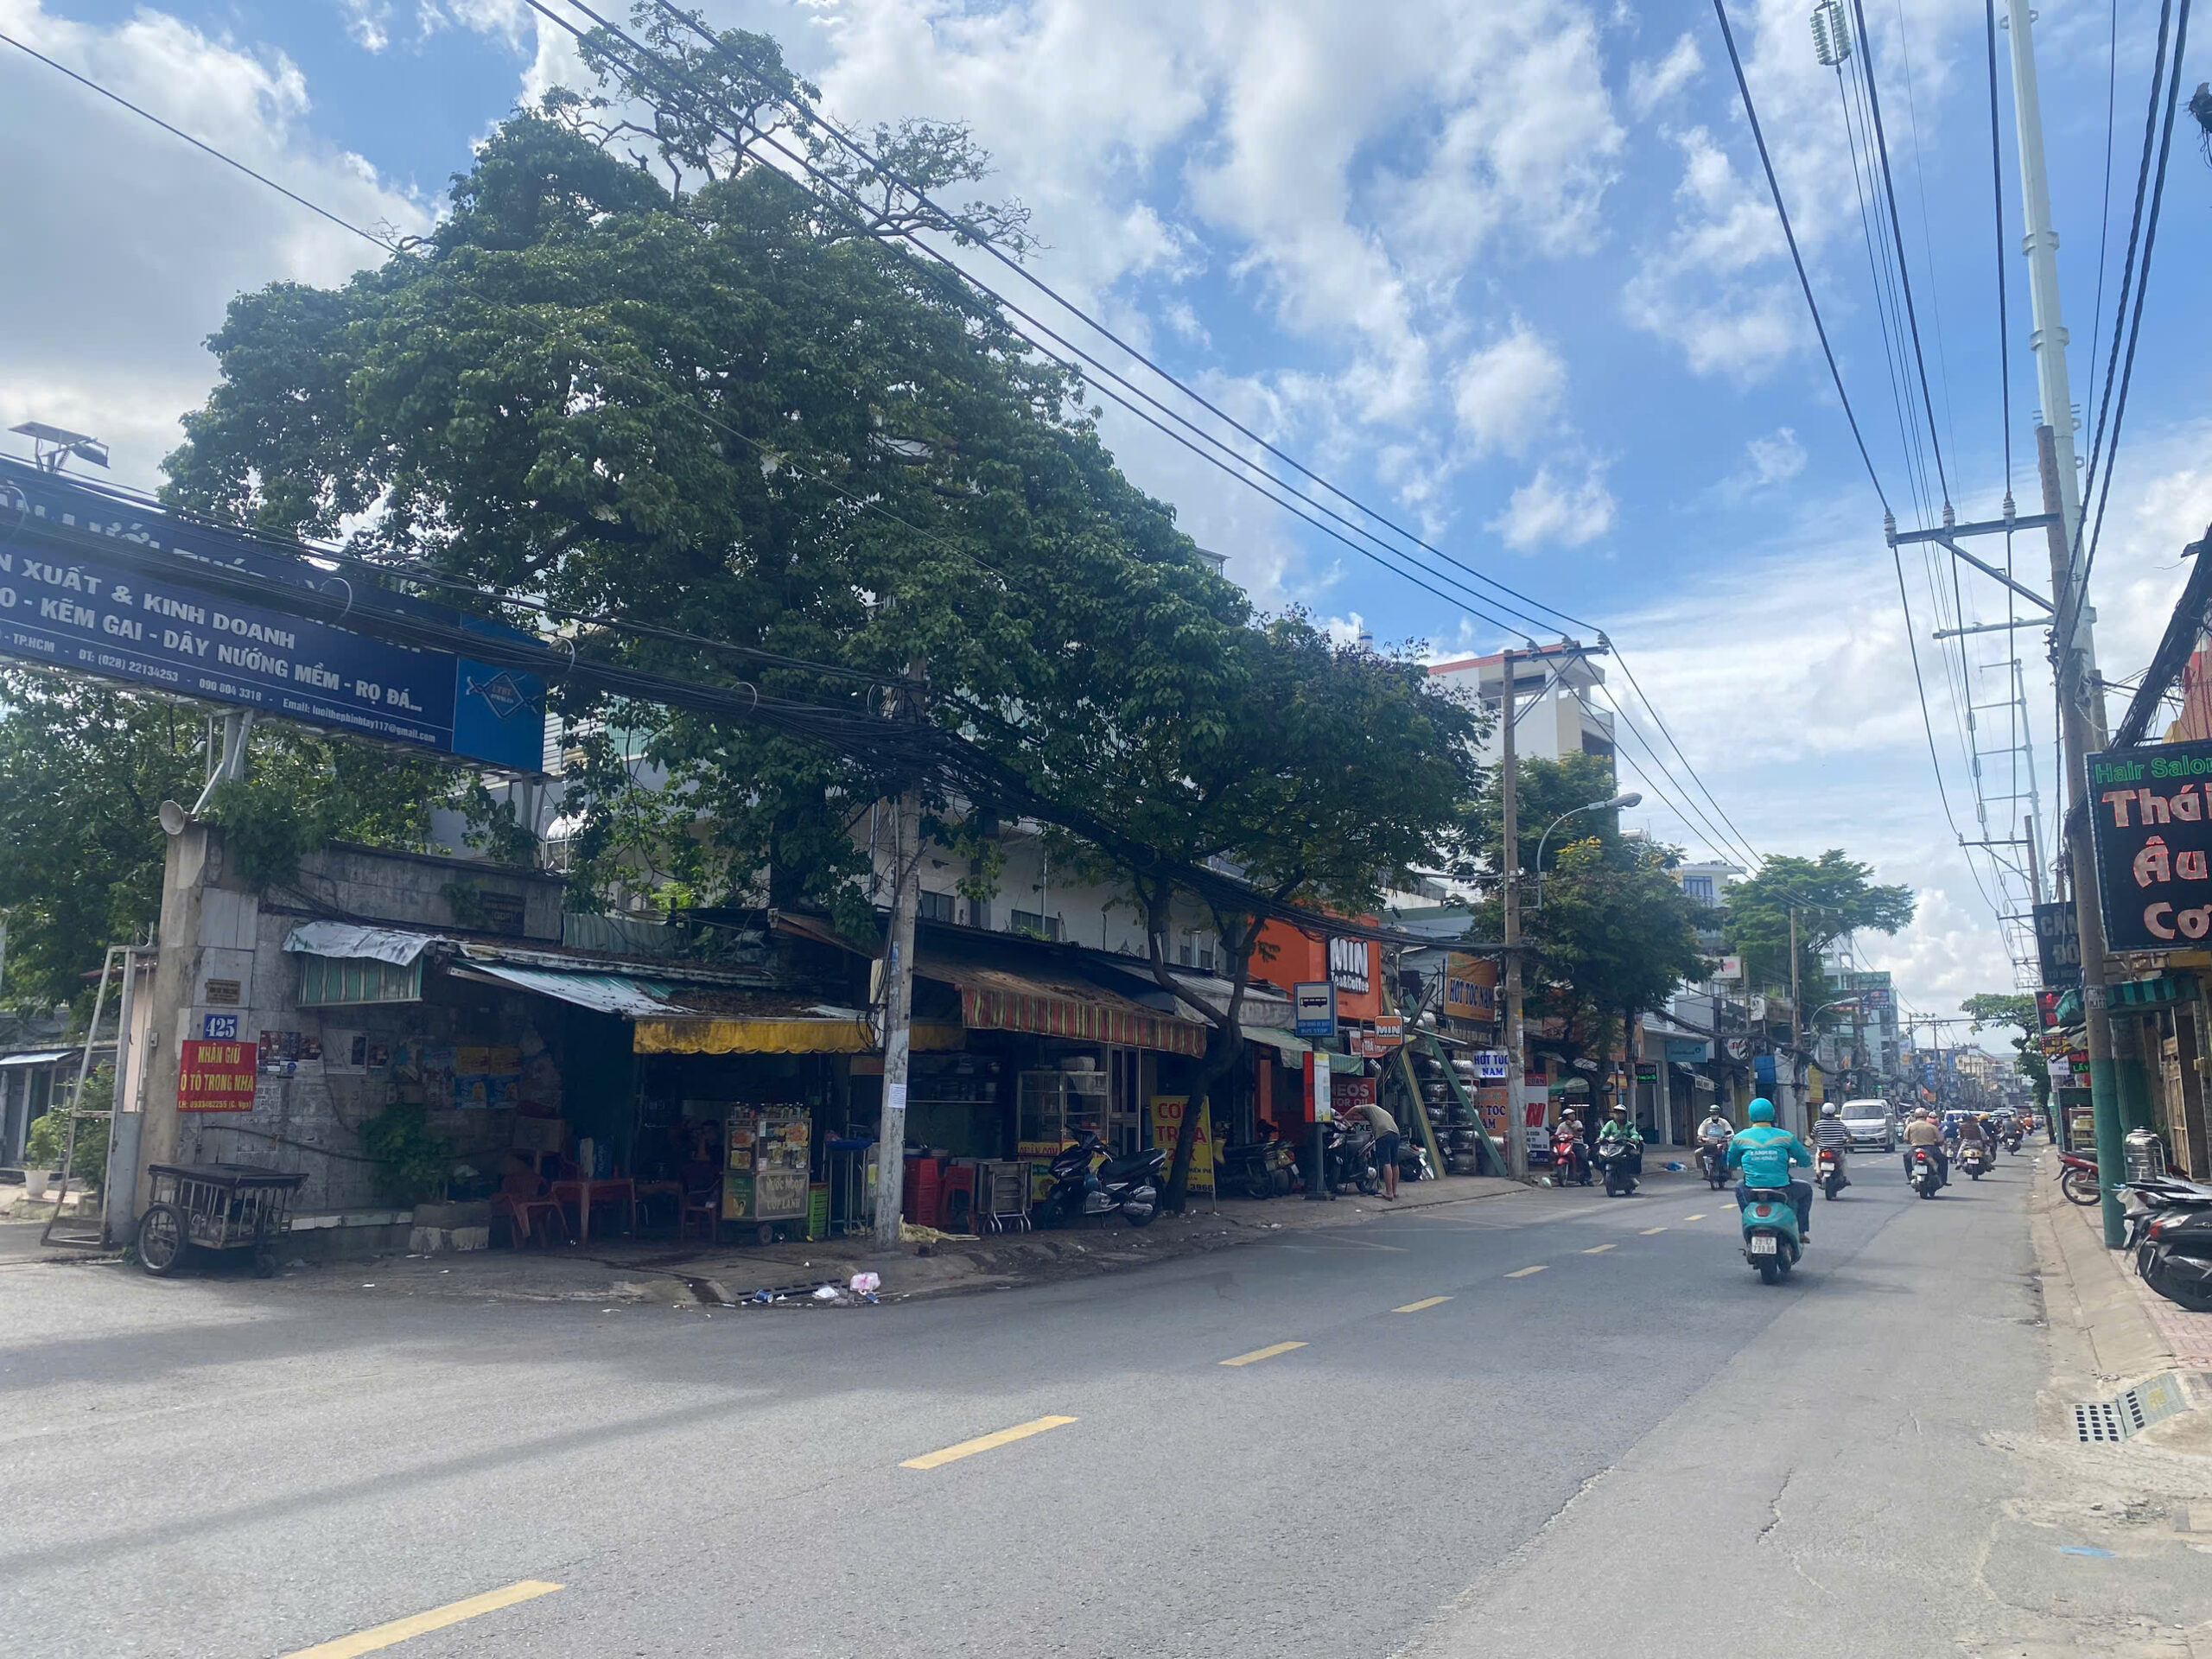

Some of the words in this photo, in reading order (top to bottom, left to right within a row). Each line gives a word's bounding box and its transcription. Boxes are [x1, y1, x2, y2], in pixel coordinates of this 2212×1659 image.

[21, 558, 102, 594] XUẤT
[111, 585, 132, 605] &
[143, 594, 205, 625] KINH
[213, 613, 296, 649] DOANH
[40, 597, 95, 629] KẼM
[103, 614, 143, 641] GAI
[163, 629, 210, 657] DÂY
[295, 662, 339, 690] MỀM
[355, 679, 380, 704] RỌ
[13, 632, 54, 652] TP.HCM
[99, 653, 126, 671] (028)
[129, 661, 179, 682] 22134253
[199, 677, 217, 692] 090
[283, 698, 309, 713] Email:
[2095, 760, 2145, 784] Hair
[2133, 836, 2208, 888] Âu
[1330, 937, 1369, 978] MIN
[1331, 972, 1370, 993] Tea&Coffee
[206, 1018, 235, 1038] 425
[1376, 1025, 1401, 1034] MIN
[180, 1070, 188, 1091] Ô
[190, 1070, 201, 1091] TÔ
[204, 1073, 232, 1091] TRONG
[1482, 1067, 1503, 1076] NAM
[1155, 1125, 1208, 1143] TRA
